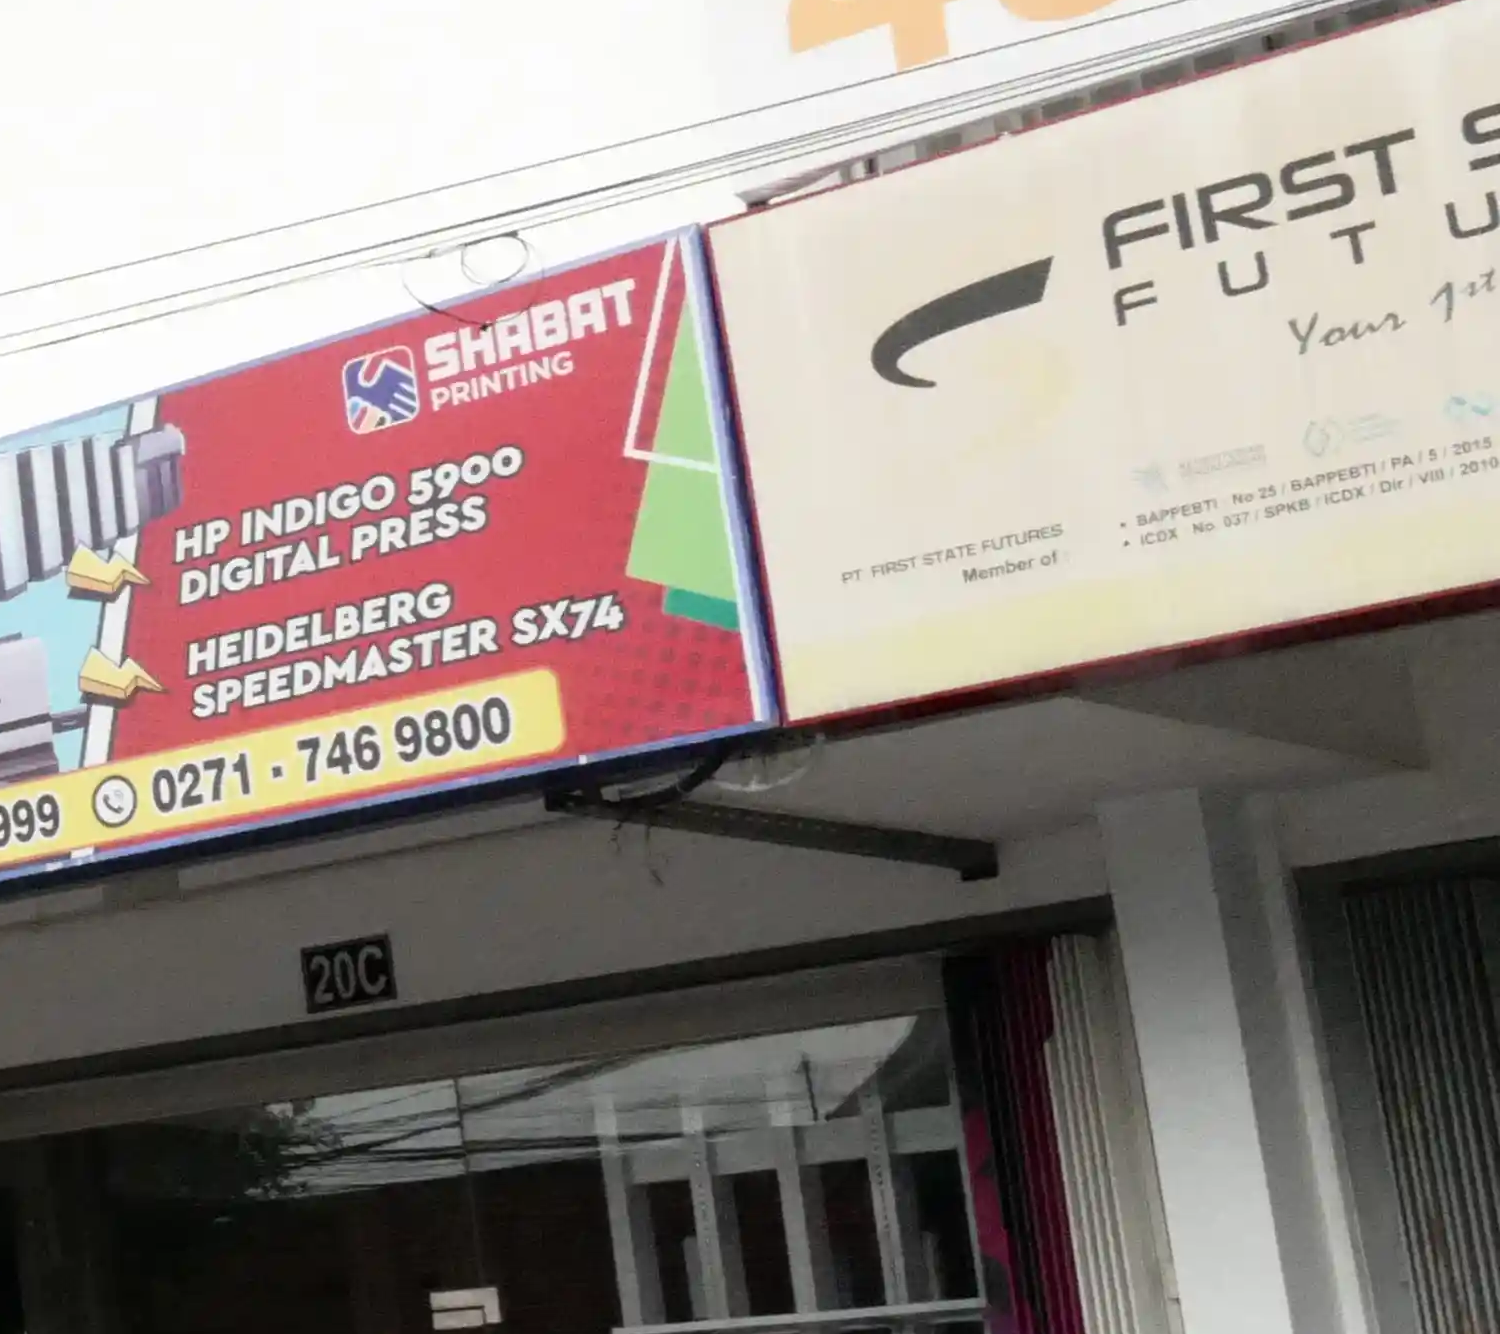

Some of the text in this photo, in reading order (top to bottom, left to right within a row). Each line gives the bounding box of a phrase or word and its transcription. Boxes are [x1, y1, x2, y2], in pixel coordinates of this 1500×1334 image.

[1102, 128, 1415, 270] FIRST
[423, 279, 637, 381] SHABAT
[1288, 312, 1406, 354] Your
[430, 352, 574, 410] PRINTING
[174, 446, 524, 563] HP INDIGO 5900
[179, 495, 488, 605] DIGITAL PRESS
[841, 524, 1064, 583] PT FIRST STATE FUTURES
[962, 551, 1057, 583] Member of
[187, 583, 453, 676] HEIDELBERG
[191, 595, 625, 720] SPEEDMASTER SX74
[152, 695, 512, 814] 0271 746 9800
[311, 945, 387, 1004] 20C
